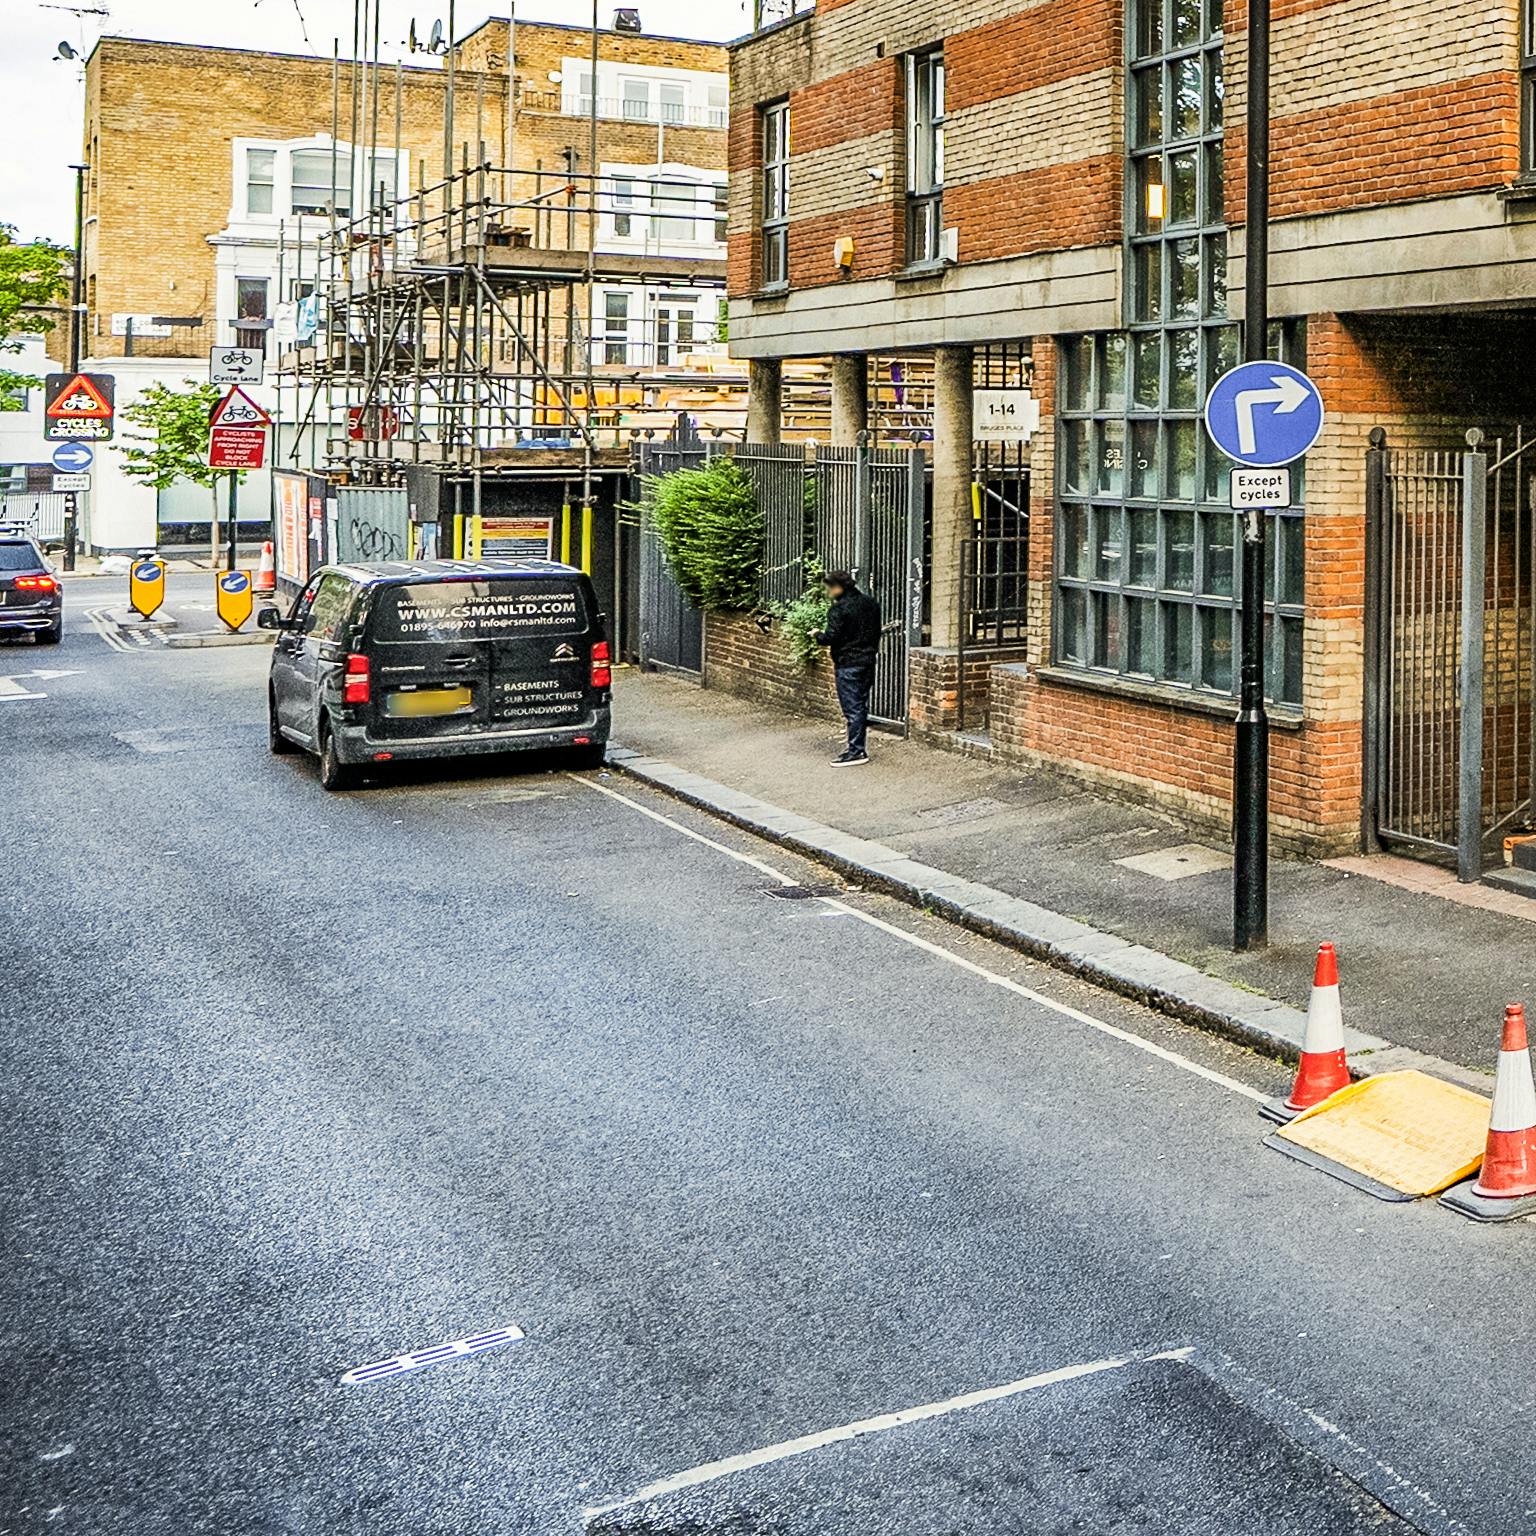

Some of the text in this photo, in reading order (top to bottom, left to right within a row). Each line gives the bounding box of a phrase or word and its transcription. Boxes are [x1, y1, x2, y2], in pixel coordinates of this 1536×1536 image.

[213, 374, 238, 382] Cycle
[989, 404, 1015, 415] 1-14
[57, 418, 103, 428] CYCLES
[49, 427, 109, 437] CROSSING
[213, 436, 263, 444] APPROACHING
[1238, 475, 1283, 487] Except
[1240, 489, 1281, 502] cycles
[467, 595, 513, 604] STRUCTURES
[519, 593, 575, 602] GROUNDWORKS
[398, 602, 576, 620] WWW.CSMANLTD.COM
[480, 616, 576, 628] info@csmanltd.com
[503, 680, 560, 692] BASEMENTS
[504, 690, 583, 704] SUB STRUCTURES
[503, 704, 579, 717] GROUNDWORKS
